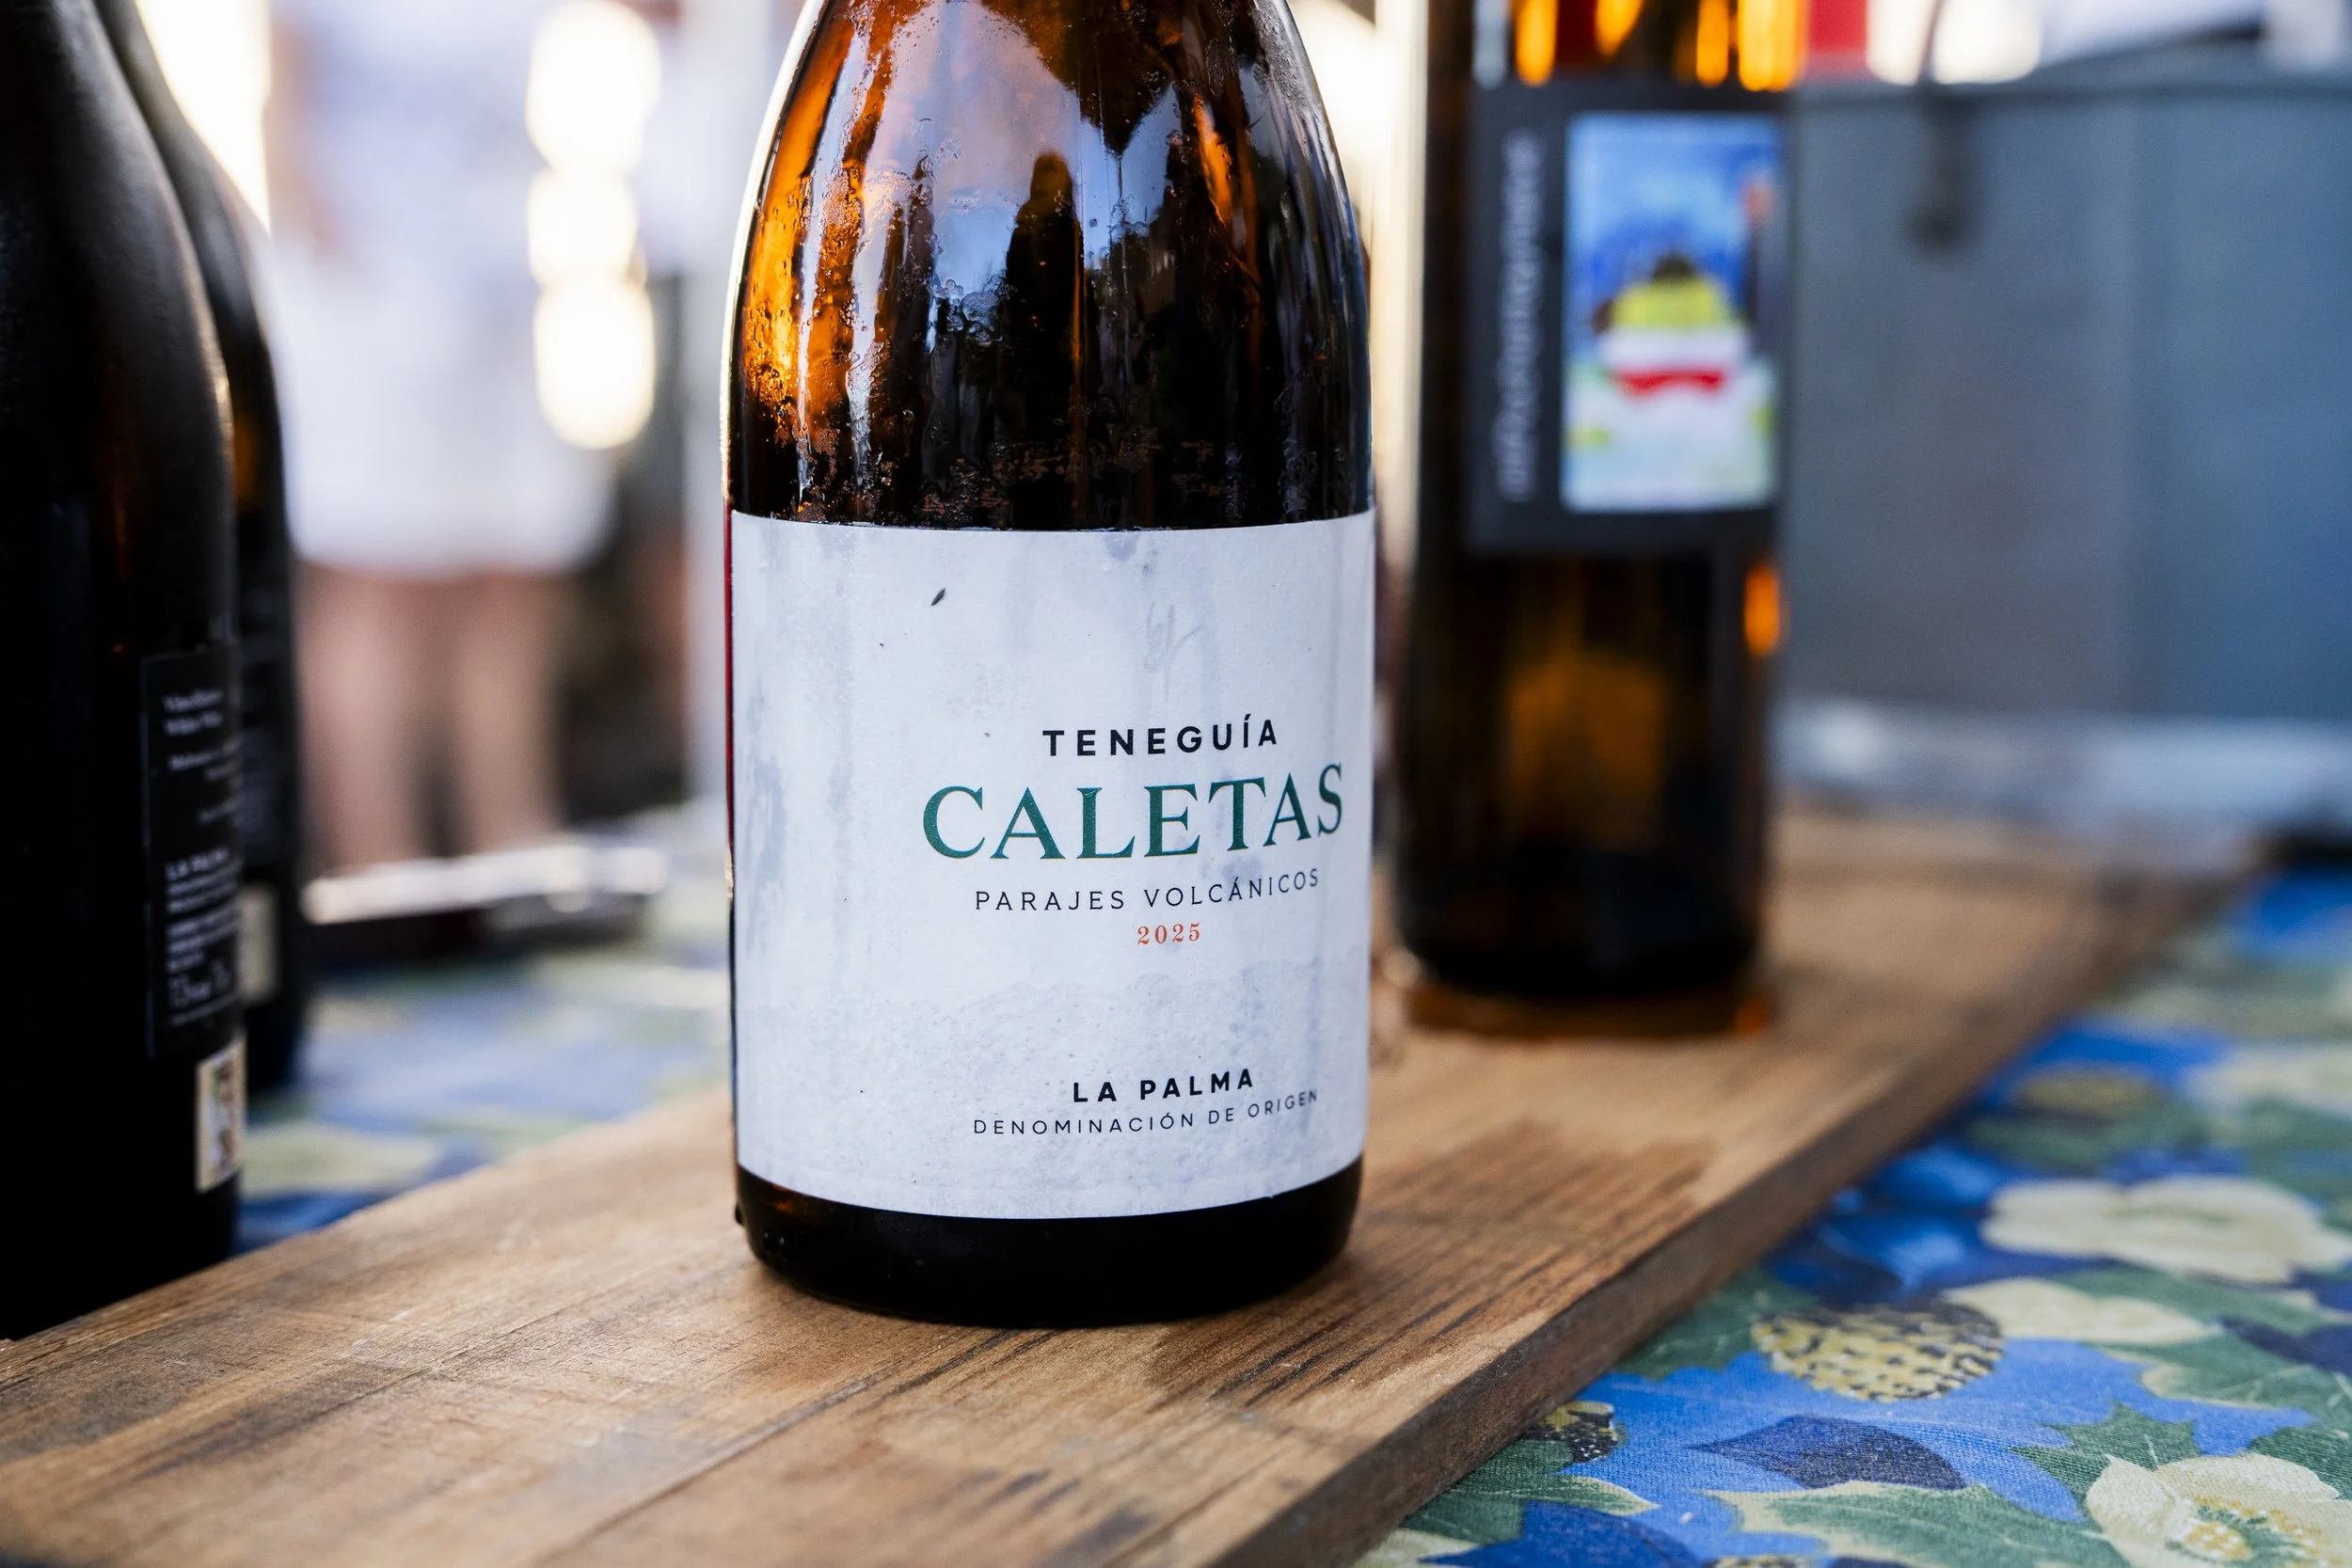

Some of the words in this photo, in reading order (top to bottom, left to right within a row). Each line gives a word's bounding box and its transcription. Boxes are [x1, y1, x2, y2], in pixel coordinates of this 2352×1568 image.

[1042, 713, 1278, 756] TENEGUÍA
[923, 763, 1343, 860] CALETAS
[975, 890, 1124, 911] PARAJES
[1143, 868, 1318, 909] VOLCÁNICOS
[1136, 923, 1201, 944] 2025
[1073, 1082, 1117, 1102] LA
[1139, 1069, 1253, 1100] PALMA
[974, 1112, 1194, 1134] DENOMINACIÓN
[1208, 1107, 1234, 1125] DE
[1248, 1089, 1317, 1118] ORIGEN
